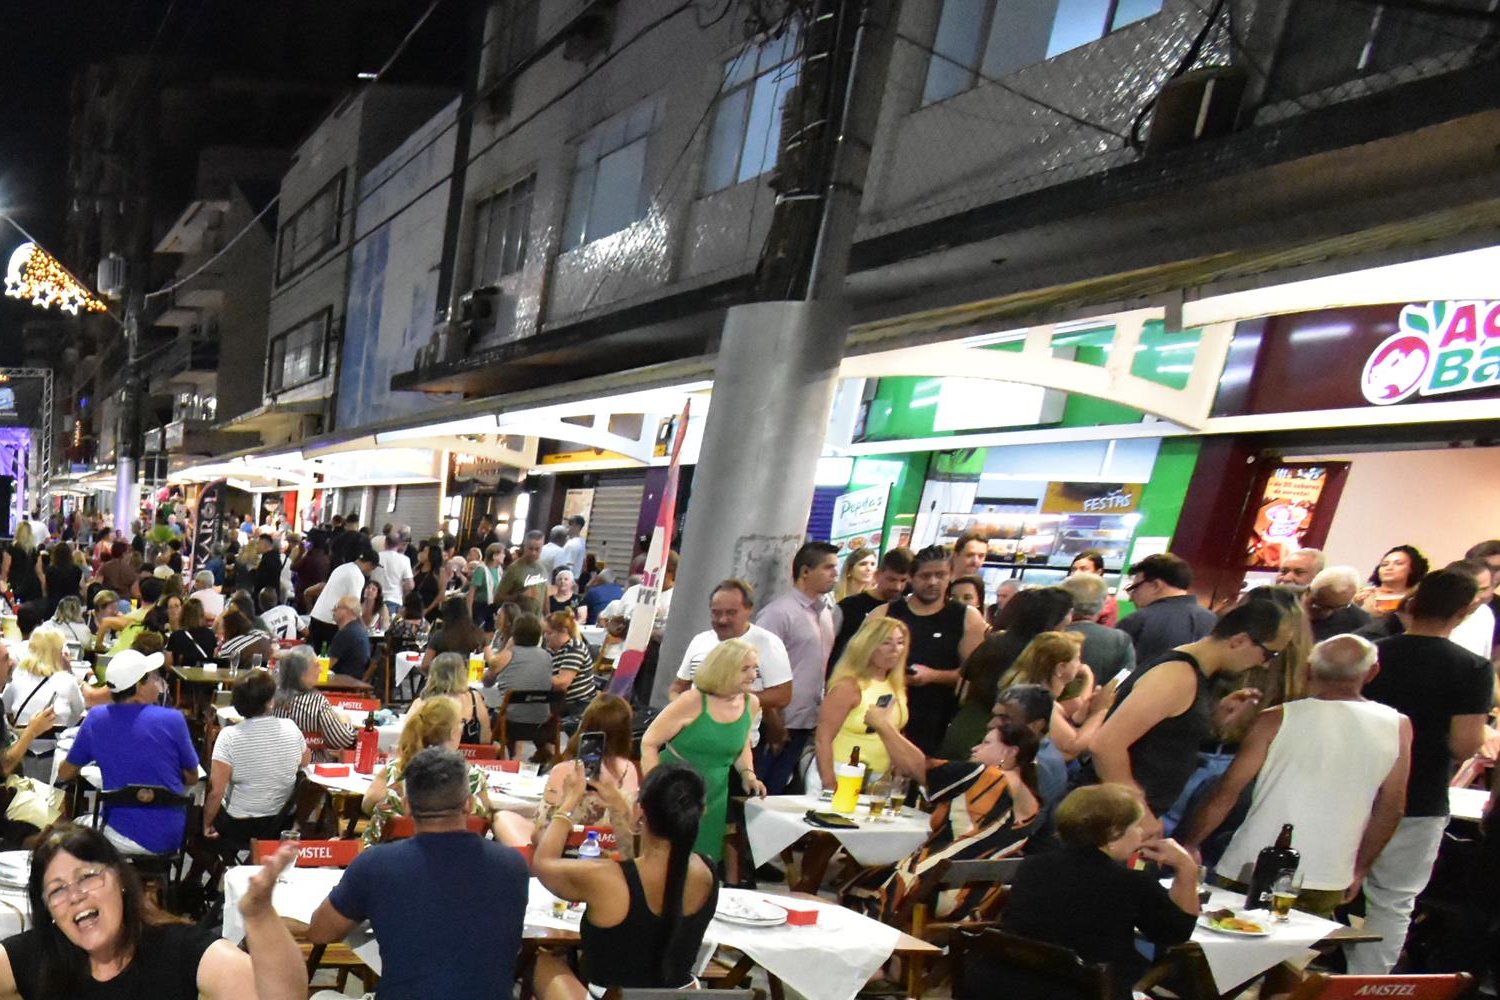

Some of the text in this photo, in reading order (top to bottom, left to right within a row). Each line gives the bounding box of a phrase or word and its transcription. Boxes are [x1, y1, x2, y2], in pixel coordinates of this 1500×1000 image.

[1084, 494, 1132, 512] FESTAS
[338, 701, 364, 710] AMSTEL
[298, 847, 333, 858] MSTEL
[1354, 984, 1417, 996] AMSTEL
